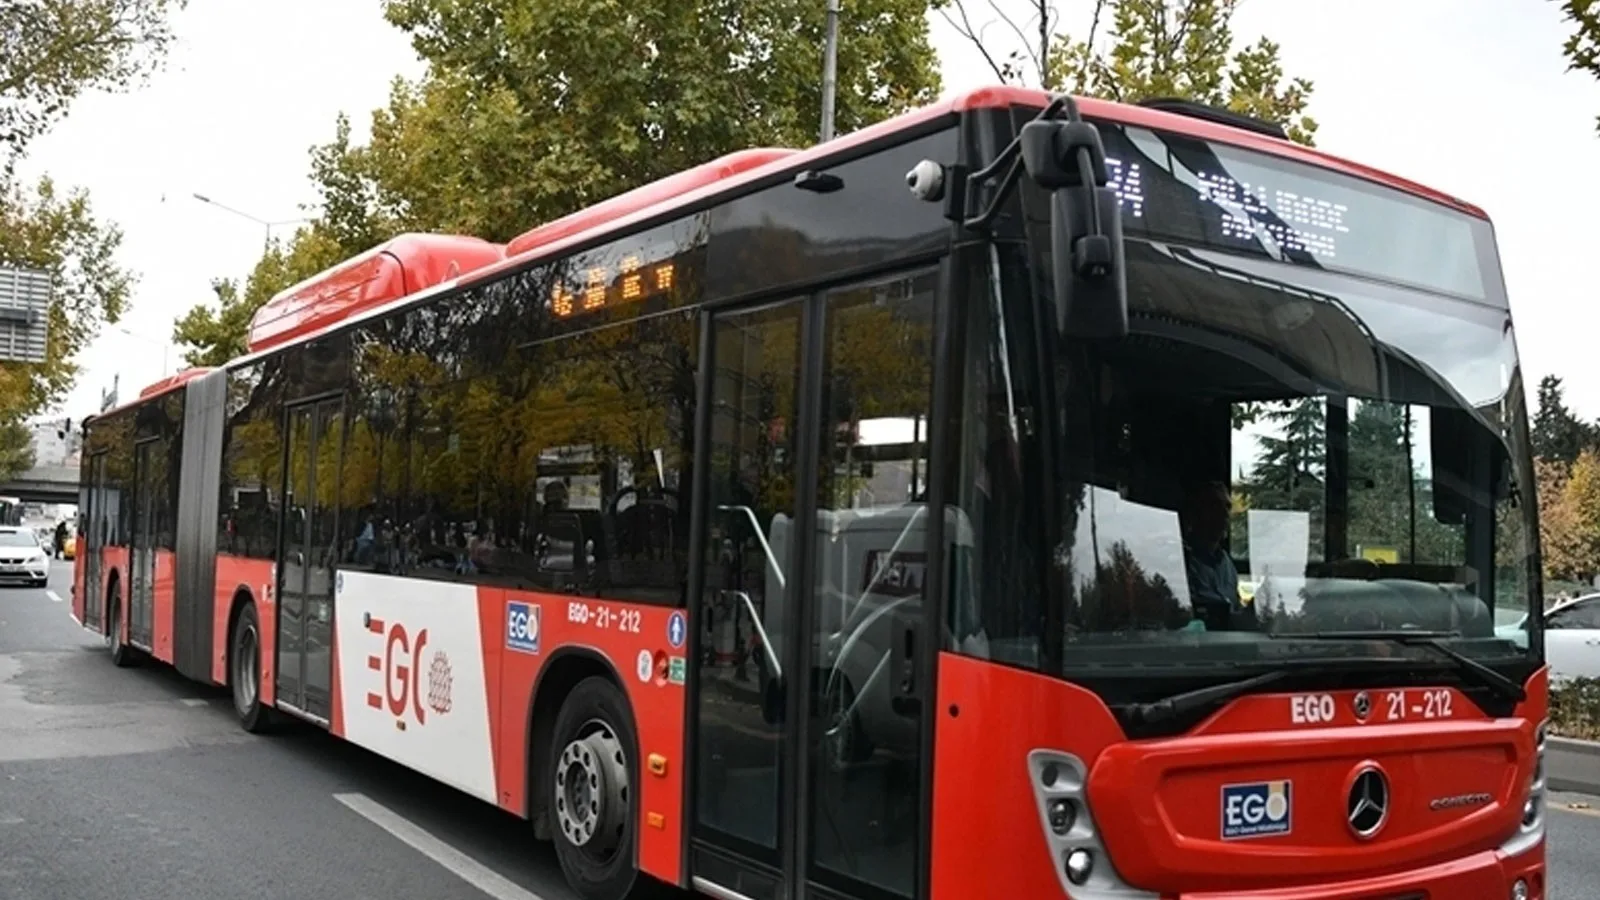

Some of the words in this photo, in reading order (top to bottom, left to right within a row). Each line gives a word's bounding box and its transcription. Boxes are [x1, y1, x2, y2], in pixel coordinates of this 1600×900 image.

[508, 611, 538, 641] EGO
[1291, 694, 1336, 724] EGO
[1386, 692, 1406, 720] 21
[1226, 793, 1287, 826] EGO
